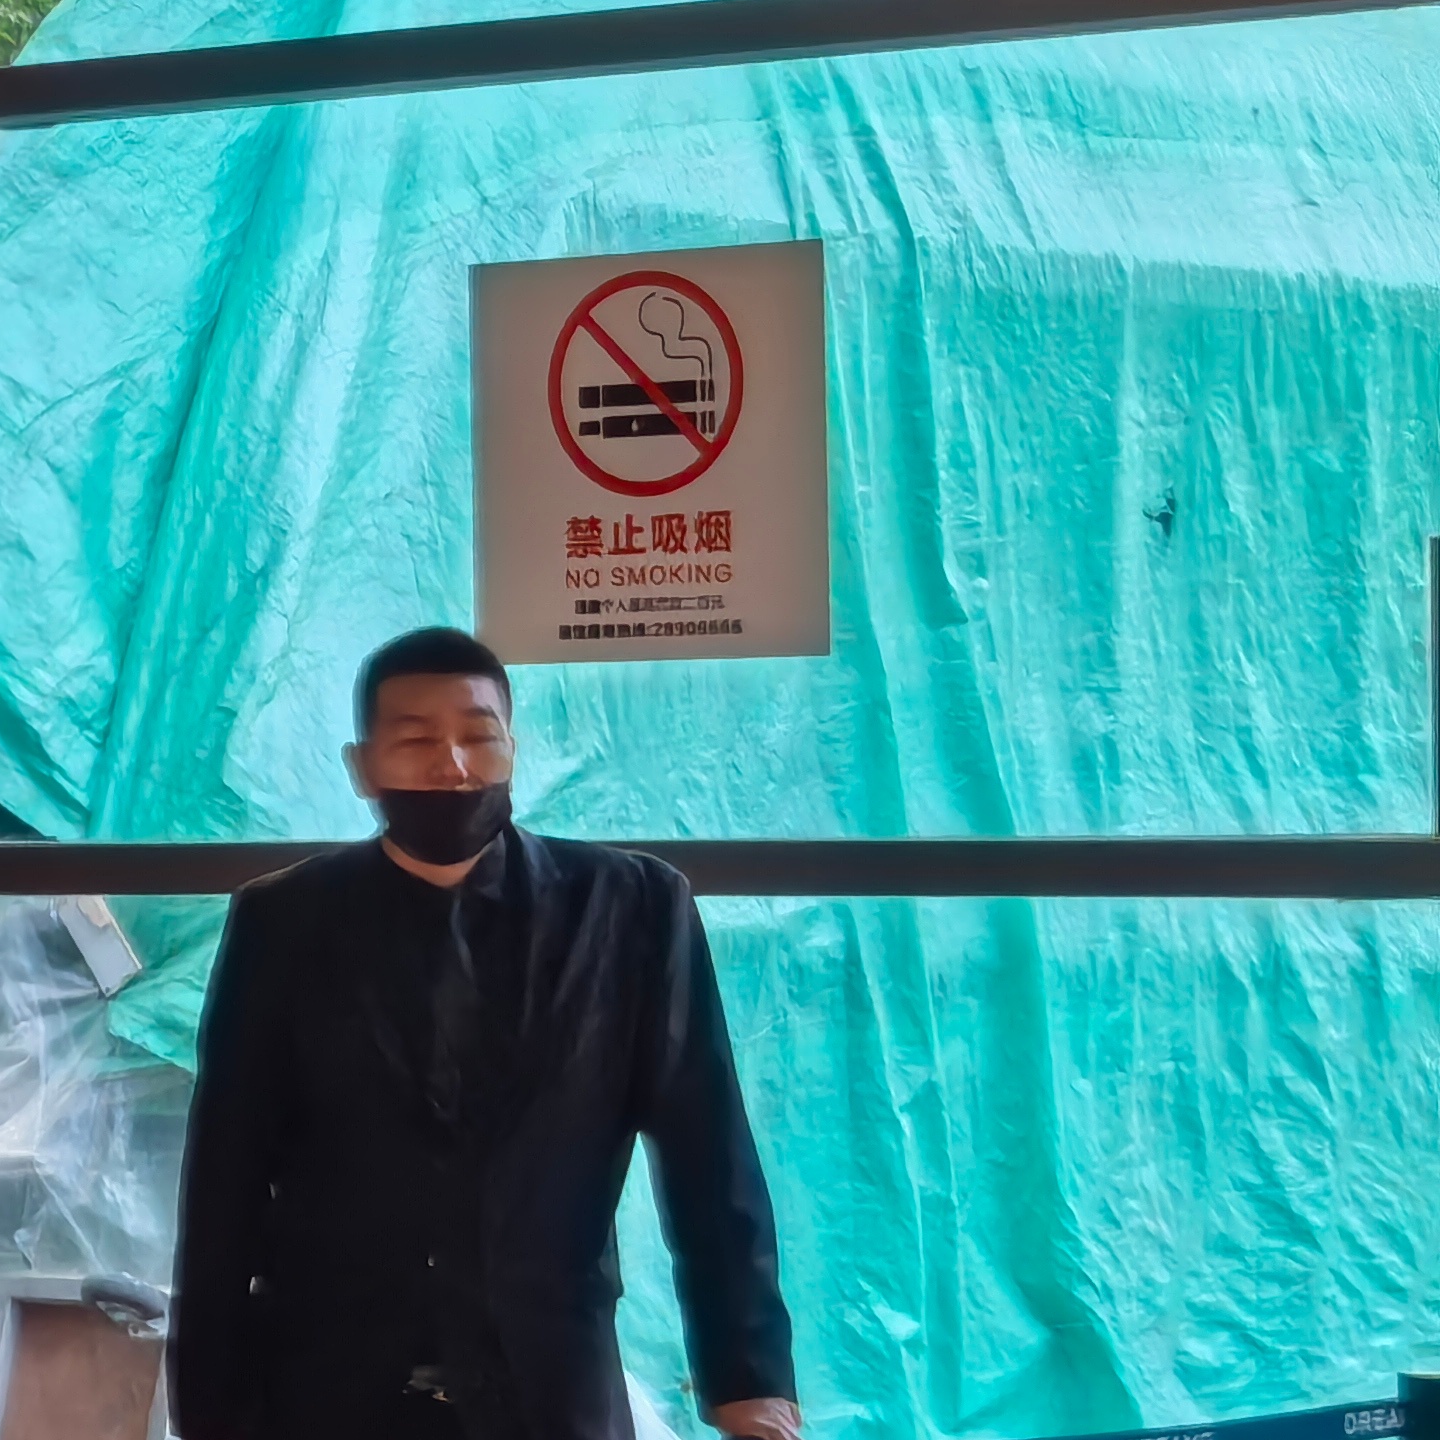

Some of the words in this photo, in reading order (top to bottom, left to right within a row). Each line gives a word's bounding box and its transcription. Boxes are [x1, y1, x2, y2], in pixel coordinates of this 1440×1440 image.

[564, 509, 732, 559] 禁止吸烟
[565, 567, 601, 589] NO
[610, 562, 733, 587] SMOKING
